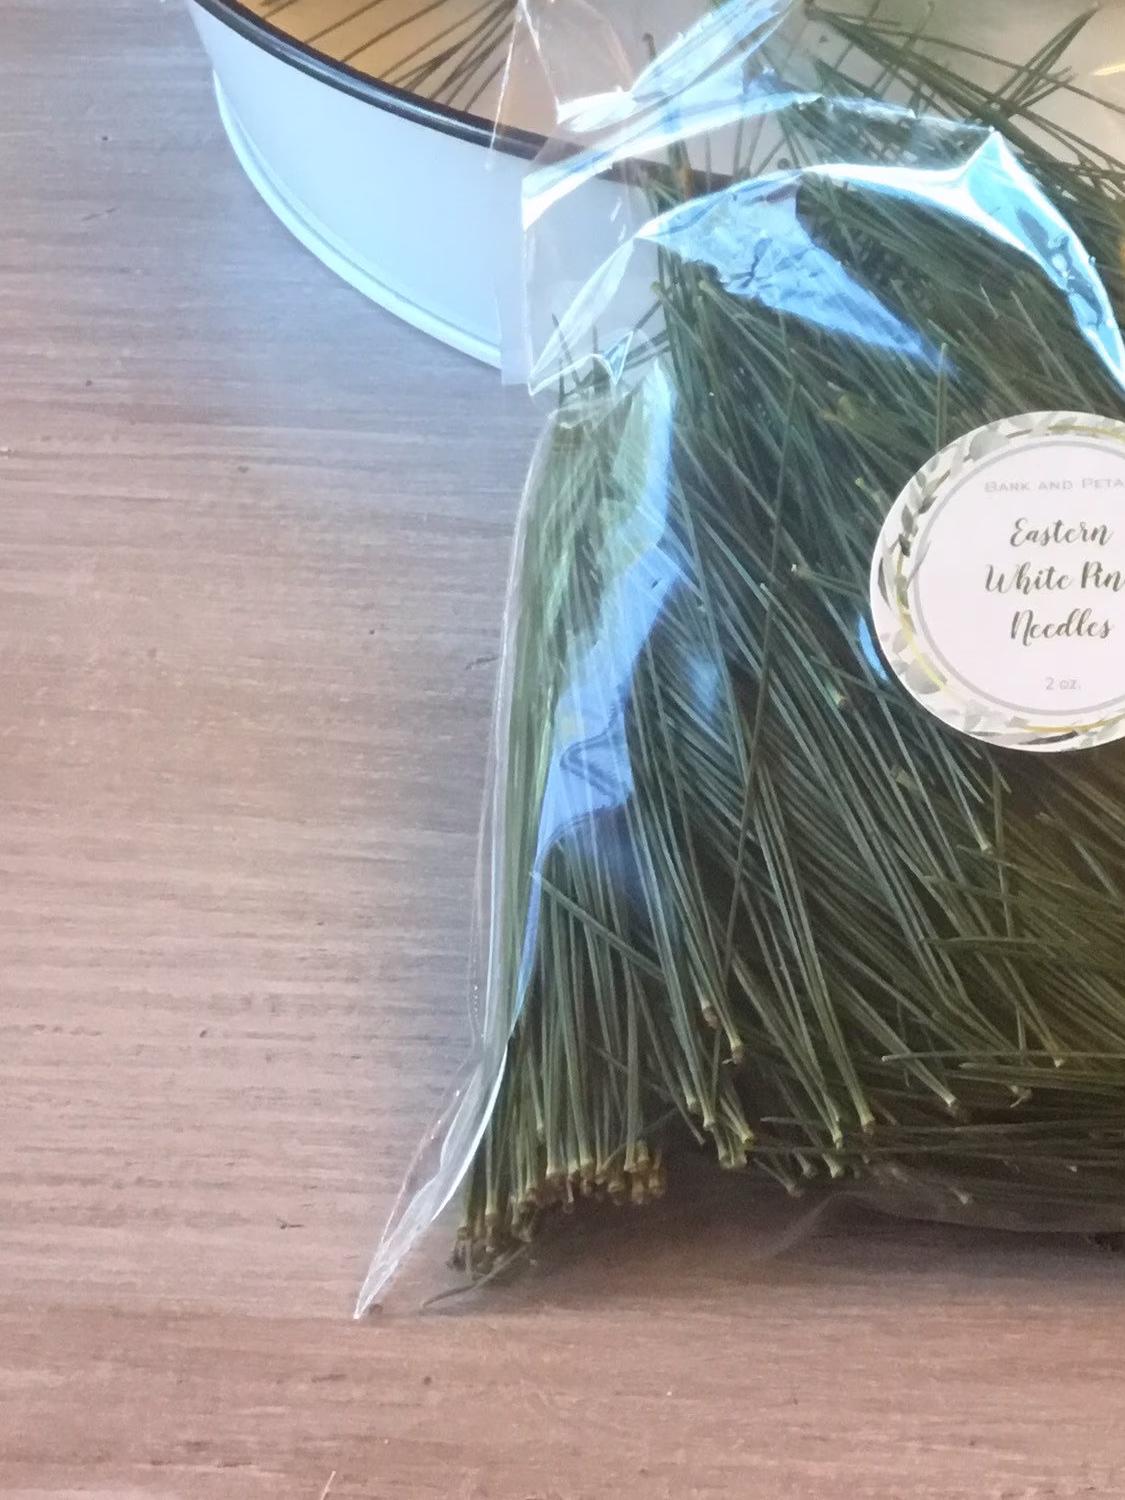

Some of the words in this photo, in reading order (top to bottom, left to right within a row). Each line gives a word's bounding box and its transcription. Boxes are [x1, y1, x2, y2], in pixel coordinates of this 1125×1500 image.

[984, 480, 1031, 493] BARK
[1038, 479, 1073, 491] AND
[1009, 516, 1114, 548] Eastern
[984, 561, 1073, 595] White
[1010, 607, 1114, 647] Needles
[1045, 676, 1055, 691] 2
[1059, 679, 1082, 691] oz.
